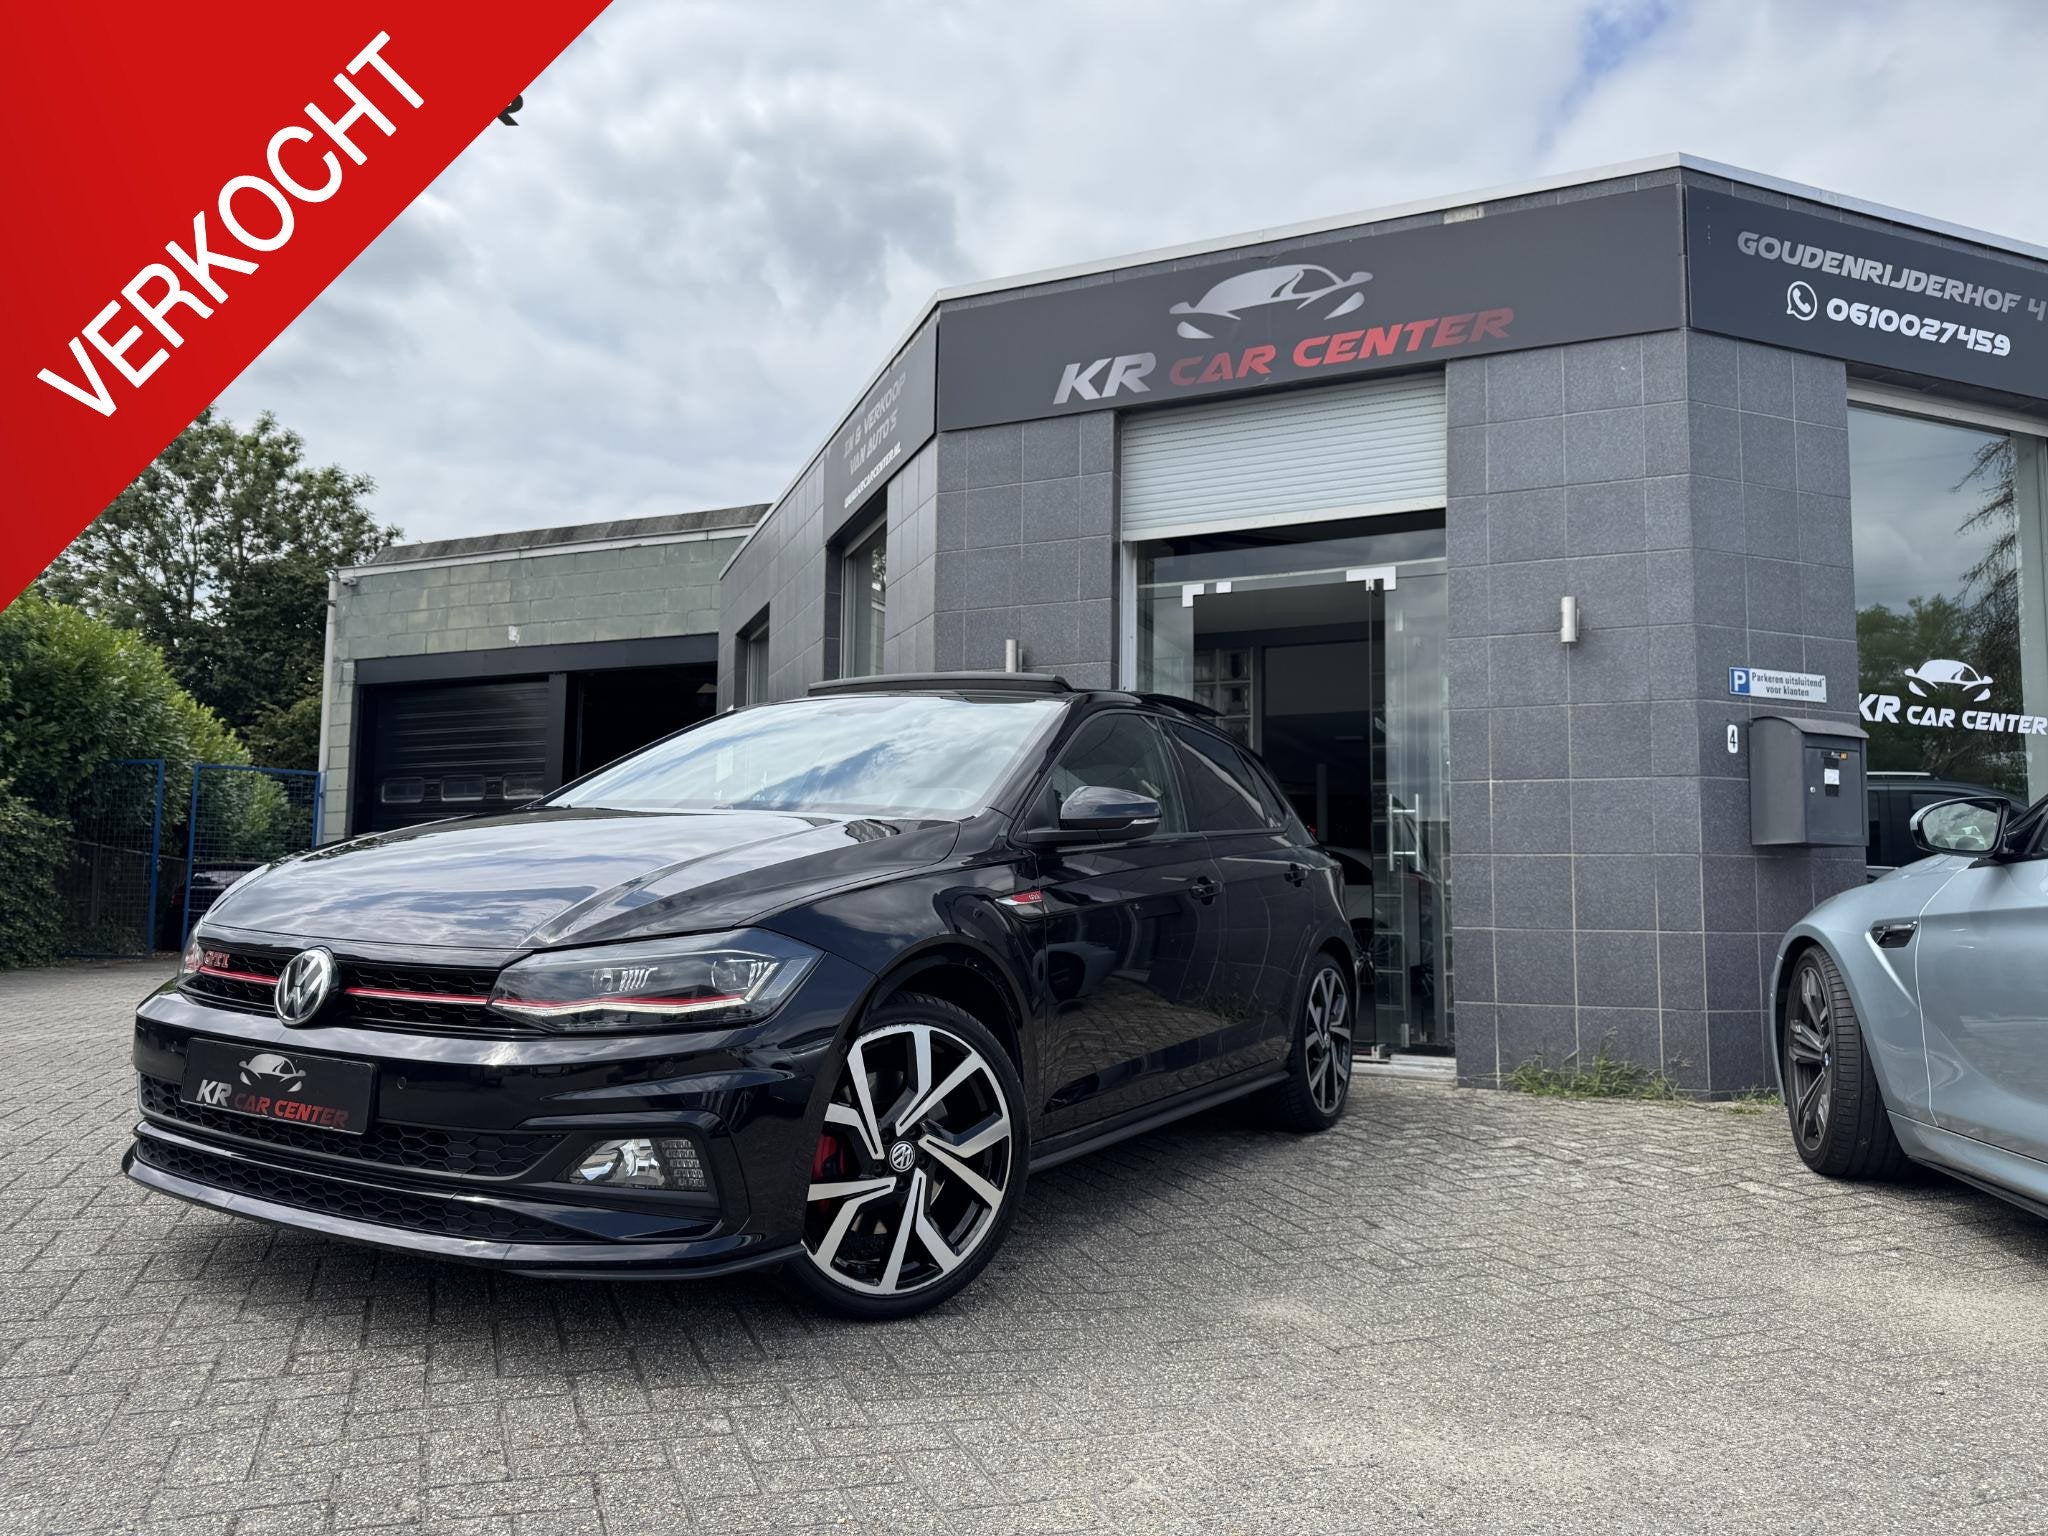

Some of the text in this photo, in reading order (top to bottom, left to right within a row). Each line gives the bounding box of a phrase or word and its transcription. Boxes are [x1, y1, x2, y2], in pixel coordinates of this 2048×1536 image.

[1737, 231, 2047, 321] GOUDENRIJDERHOF 4
[1826, 298, 2011, 357] 0610027459
[1053, 307, 1514, 405] KR CAR CENTER
[864, 371, 906, 434] VERKOOP
[850, 444, 866, 476] VAN
[1733, 670, 1747, 692] P
[1751, 672, 1822, 688] Parkeren uitsluitend
[1766, 685, 1810, 697] voor klanten
[1859, 693, 2048, 735] KR CAR CENTER
[1729, 729, 1737, 749] 4
[203, 950, 231, 969] GTI
[196, 1079, 350, 1127] KR CAR CENTER
